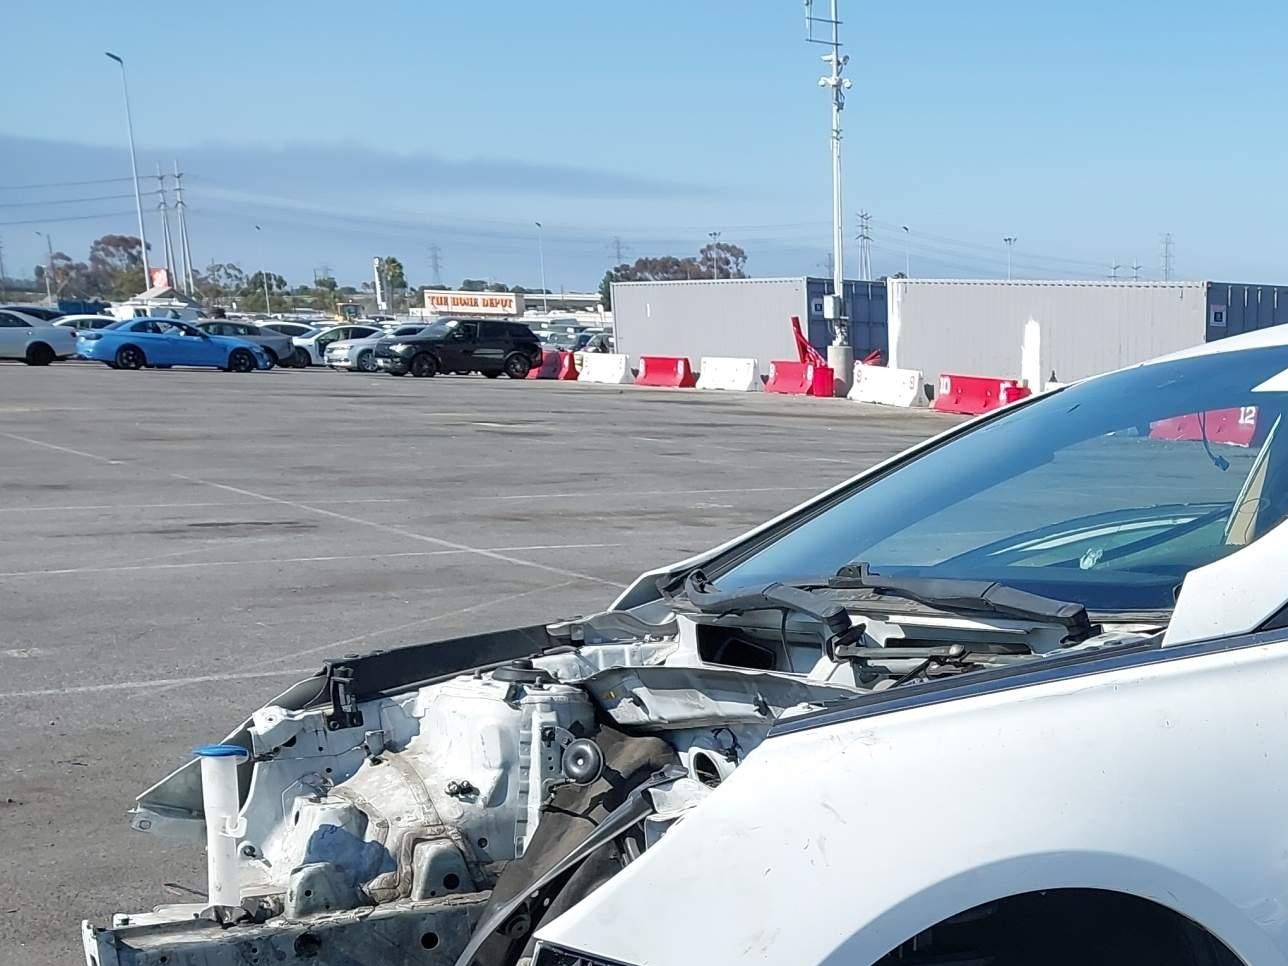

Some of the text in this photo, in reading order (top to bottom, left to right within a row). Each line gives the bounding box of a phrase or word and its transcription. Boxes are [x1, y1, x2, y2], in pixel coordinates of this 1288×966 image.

[427, 296, 449, 305] THE
[480, 298, 513, 308] DEPOT
[1238, 405, 1257, 424] 12
